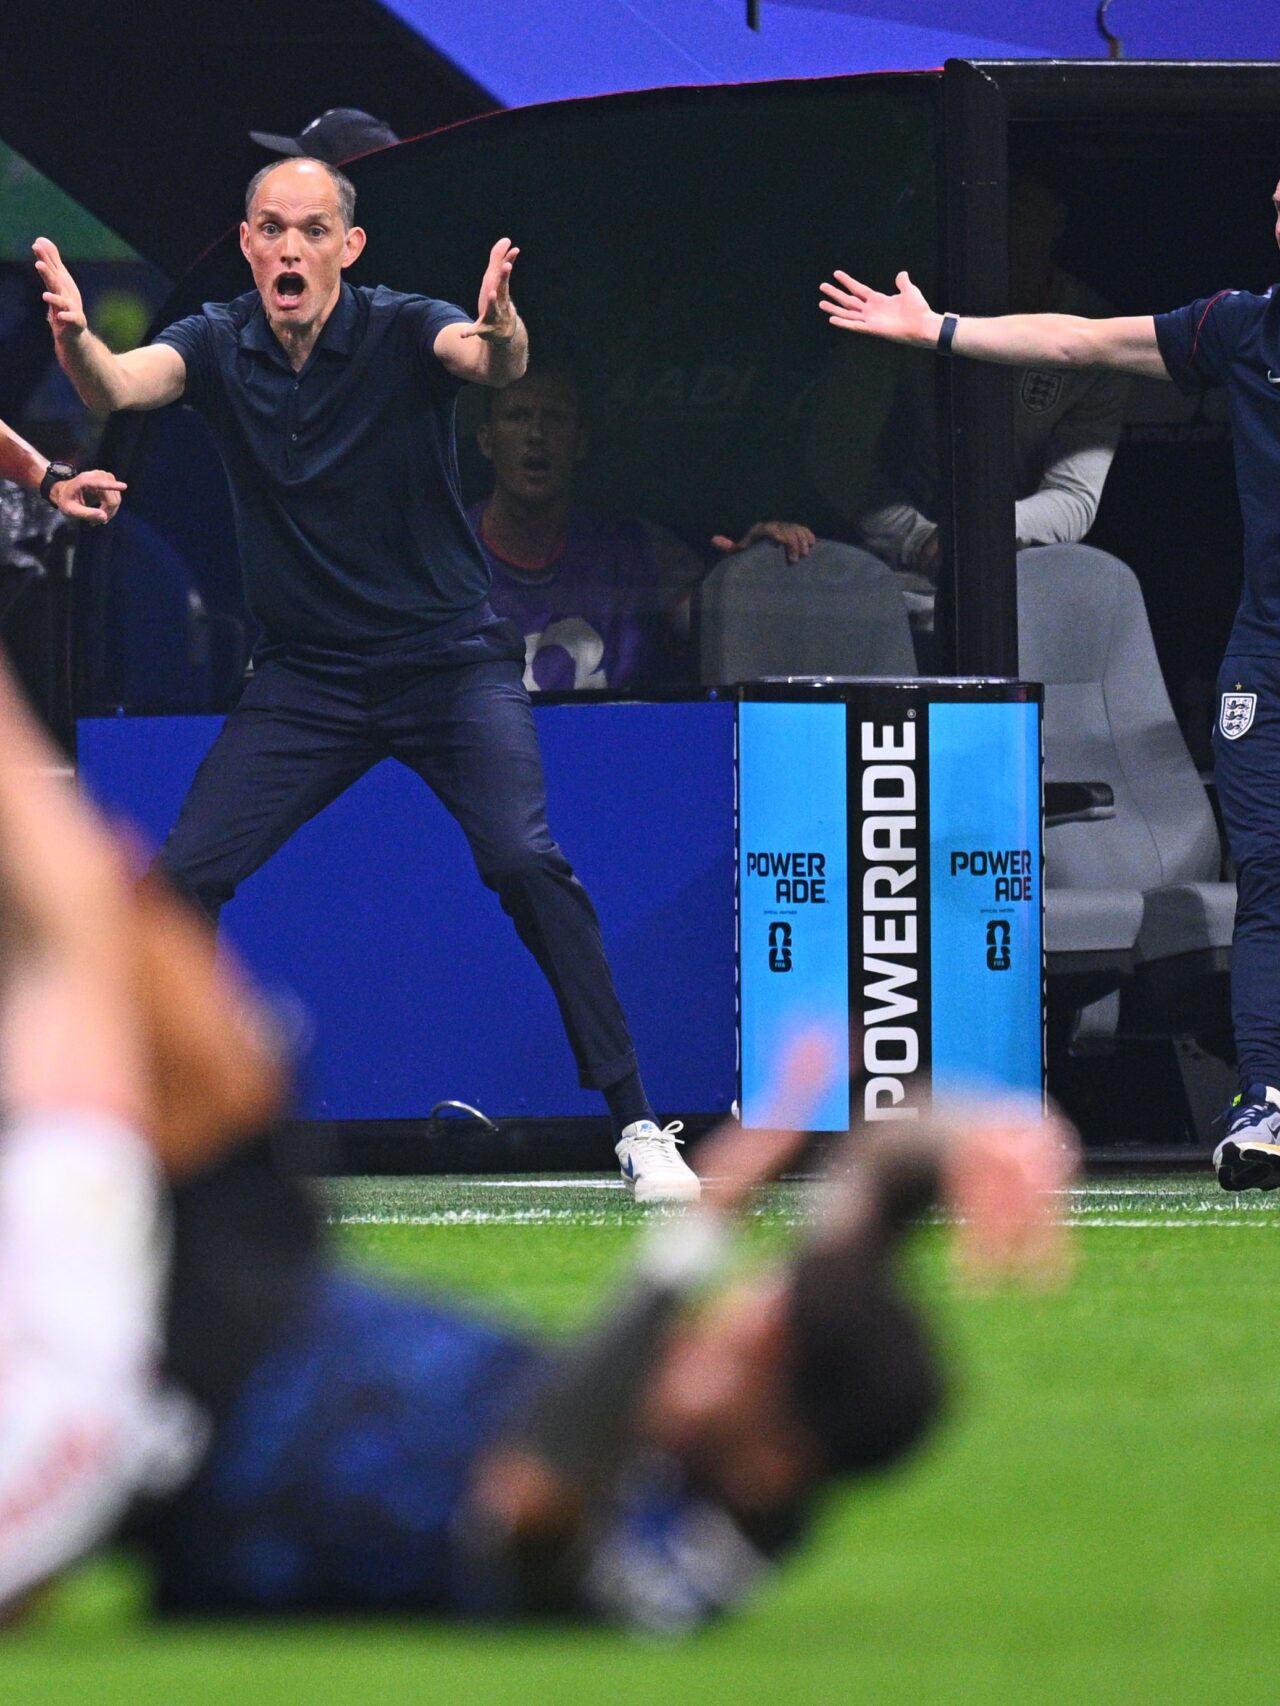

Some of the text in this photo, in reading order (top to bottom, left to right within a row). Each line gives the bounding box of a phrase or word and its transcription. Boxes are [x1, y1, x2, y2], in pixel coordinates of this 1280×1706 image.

[747, 852, 826, 877] POWER
[950, 850, 1032, 877] POWER
[775, 879, 827, 904] ADE
[995, 876, 1032, 902] ADE
[861, 721, 919, 1122] POWERADE
